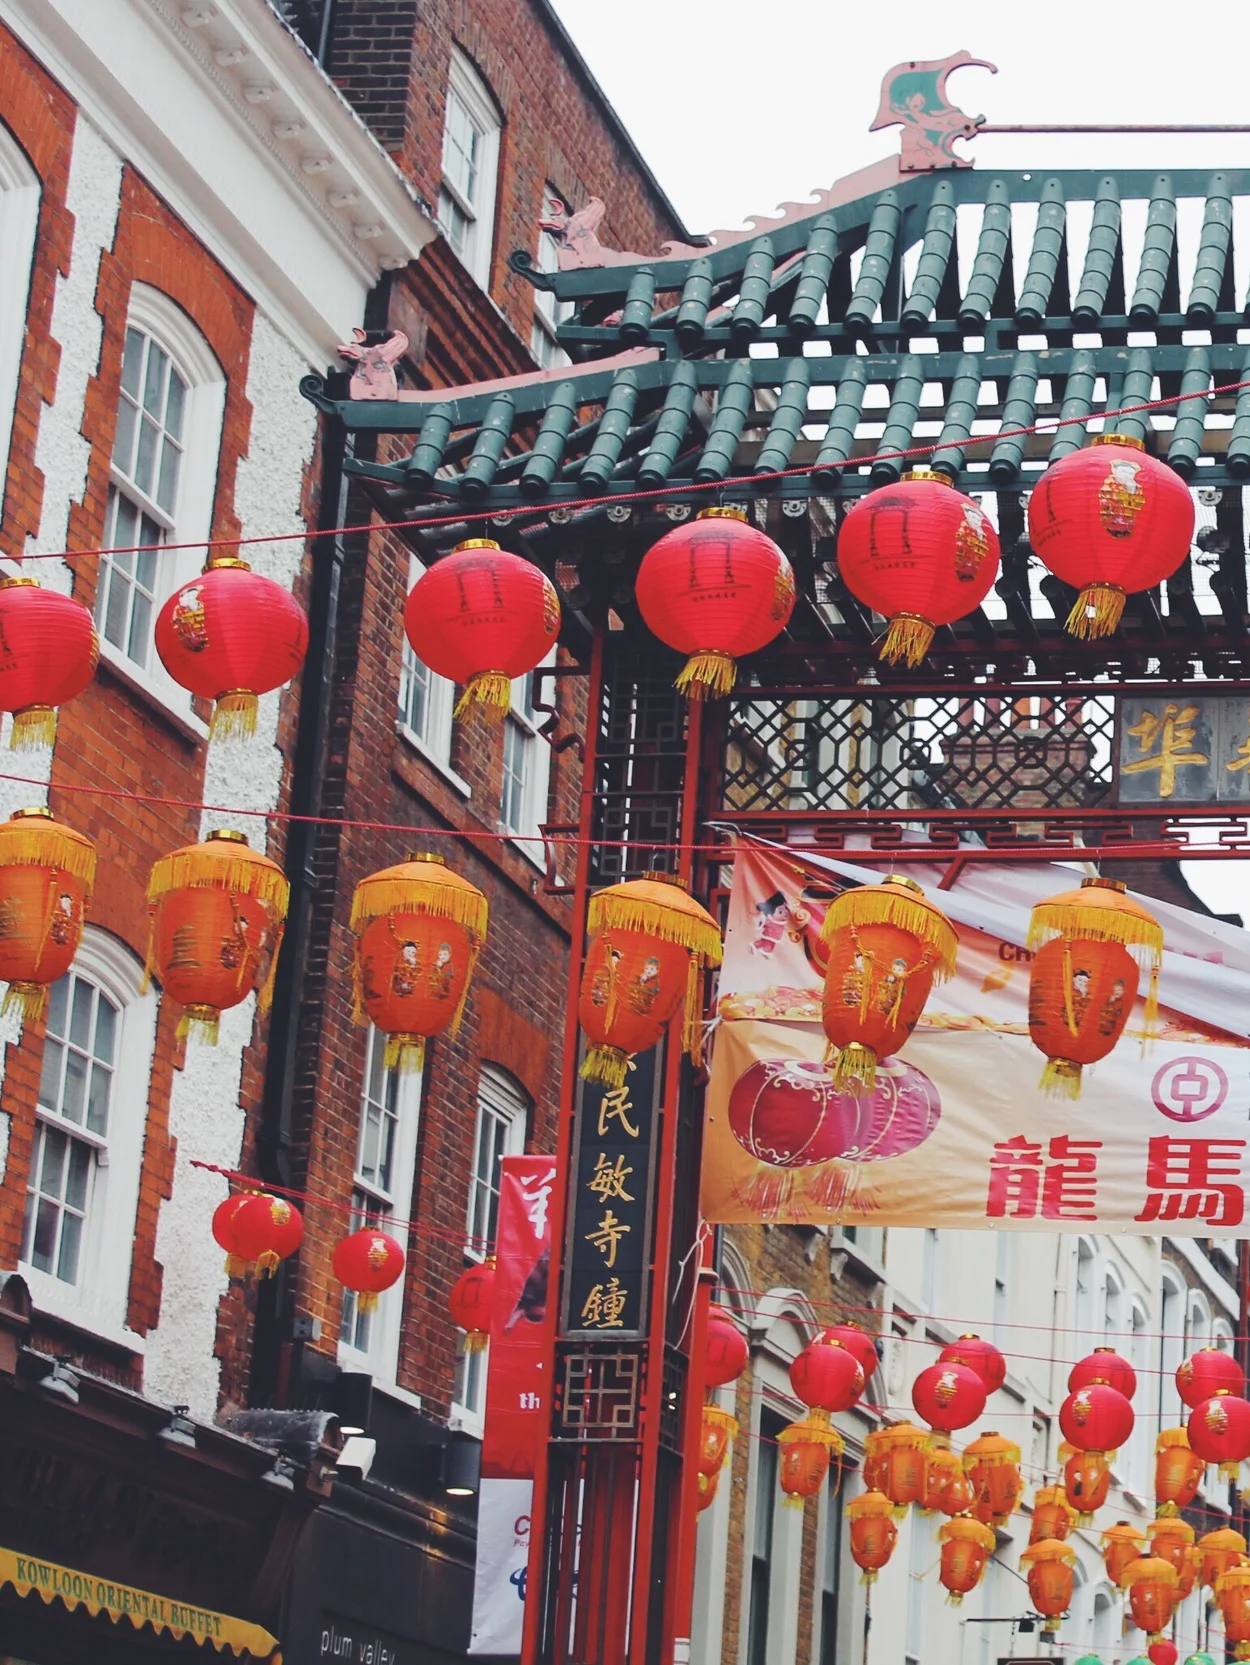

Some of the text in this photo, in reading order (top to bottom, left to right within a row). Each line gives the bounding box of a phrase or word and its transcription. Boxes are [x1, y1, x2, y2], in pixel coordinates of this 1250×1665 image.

[16, 1557, 222, 1637] KOWLOON ORIENTAL BUFFET
[320, 1625, 396, 1665] plum valley
